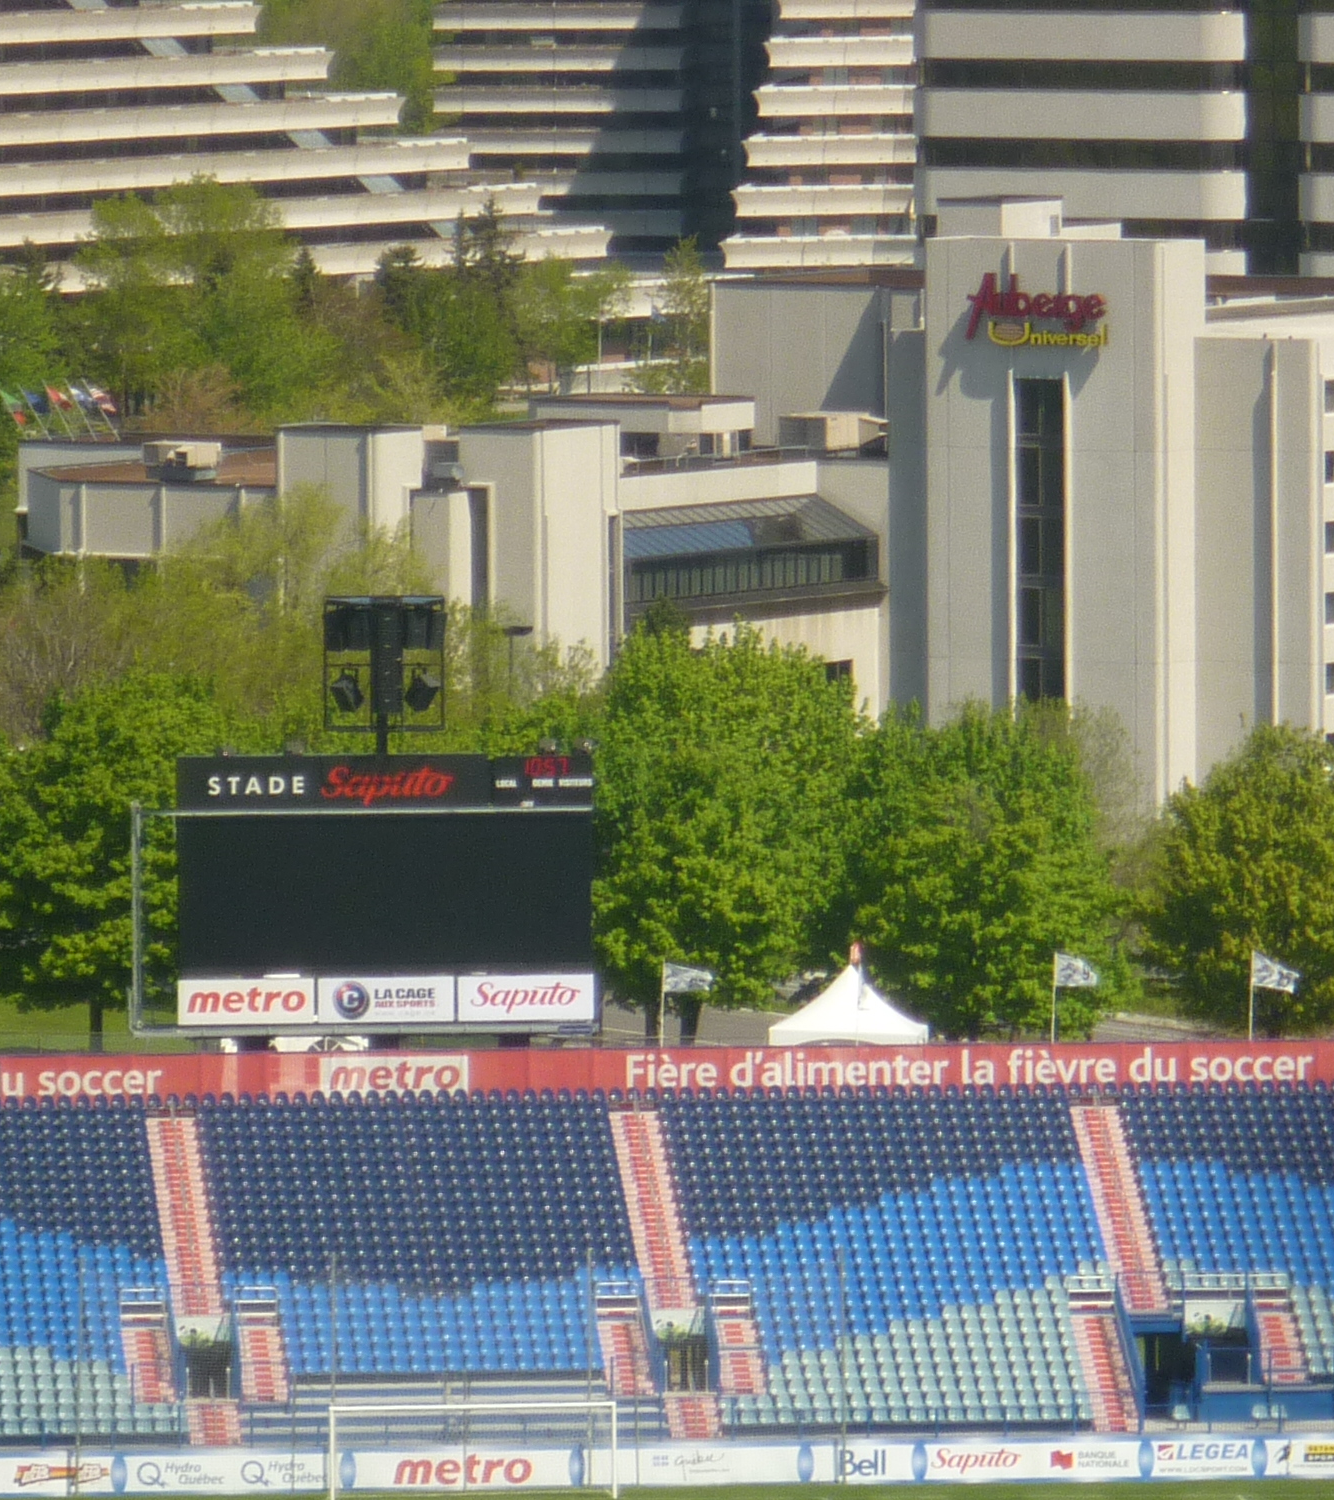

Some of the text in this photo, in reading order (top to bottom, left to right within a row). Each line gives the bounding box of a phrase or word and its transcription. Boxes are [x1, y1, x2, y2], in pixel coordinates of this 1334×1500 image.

[966, 273, 1106, 339] Auberge
[988, 321, 1108, 346] Universel
[207, 765, 455, 806] STADE Saputo
[187, 986, 307, 1014] metro
[374, 987, 435, 1000] LA CAGE
[396, 999, 435, 1008] SPORTS
[470, 981, 581, 1013] Saputo
[37, 1066, 163, 1095] soccer
[328, 1059, 462, 1092] metro
[625, 1046, 1314, 1088] Fière d'alimenter la fièvre du soccer
[839, 1449, 886, 1476] Bell
[931, 1447, 1022, 1474] Saputo
[1077, 1450, 1117, 1459] BANQUE
[1077, 1459, 1130, 1468] NATIONALE
[1176, 1443, 1249, 1460] LEGEA
[164, 1461, 202, 1475] Hydro
[178, 1473, 225, 1485] Québec
[268, 1460, 306, 1474] Hydro
[393, 1453, 533, 1485] metro
